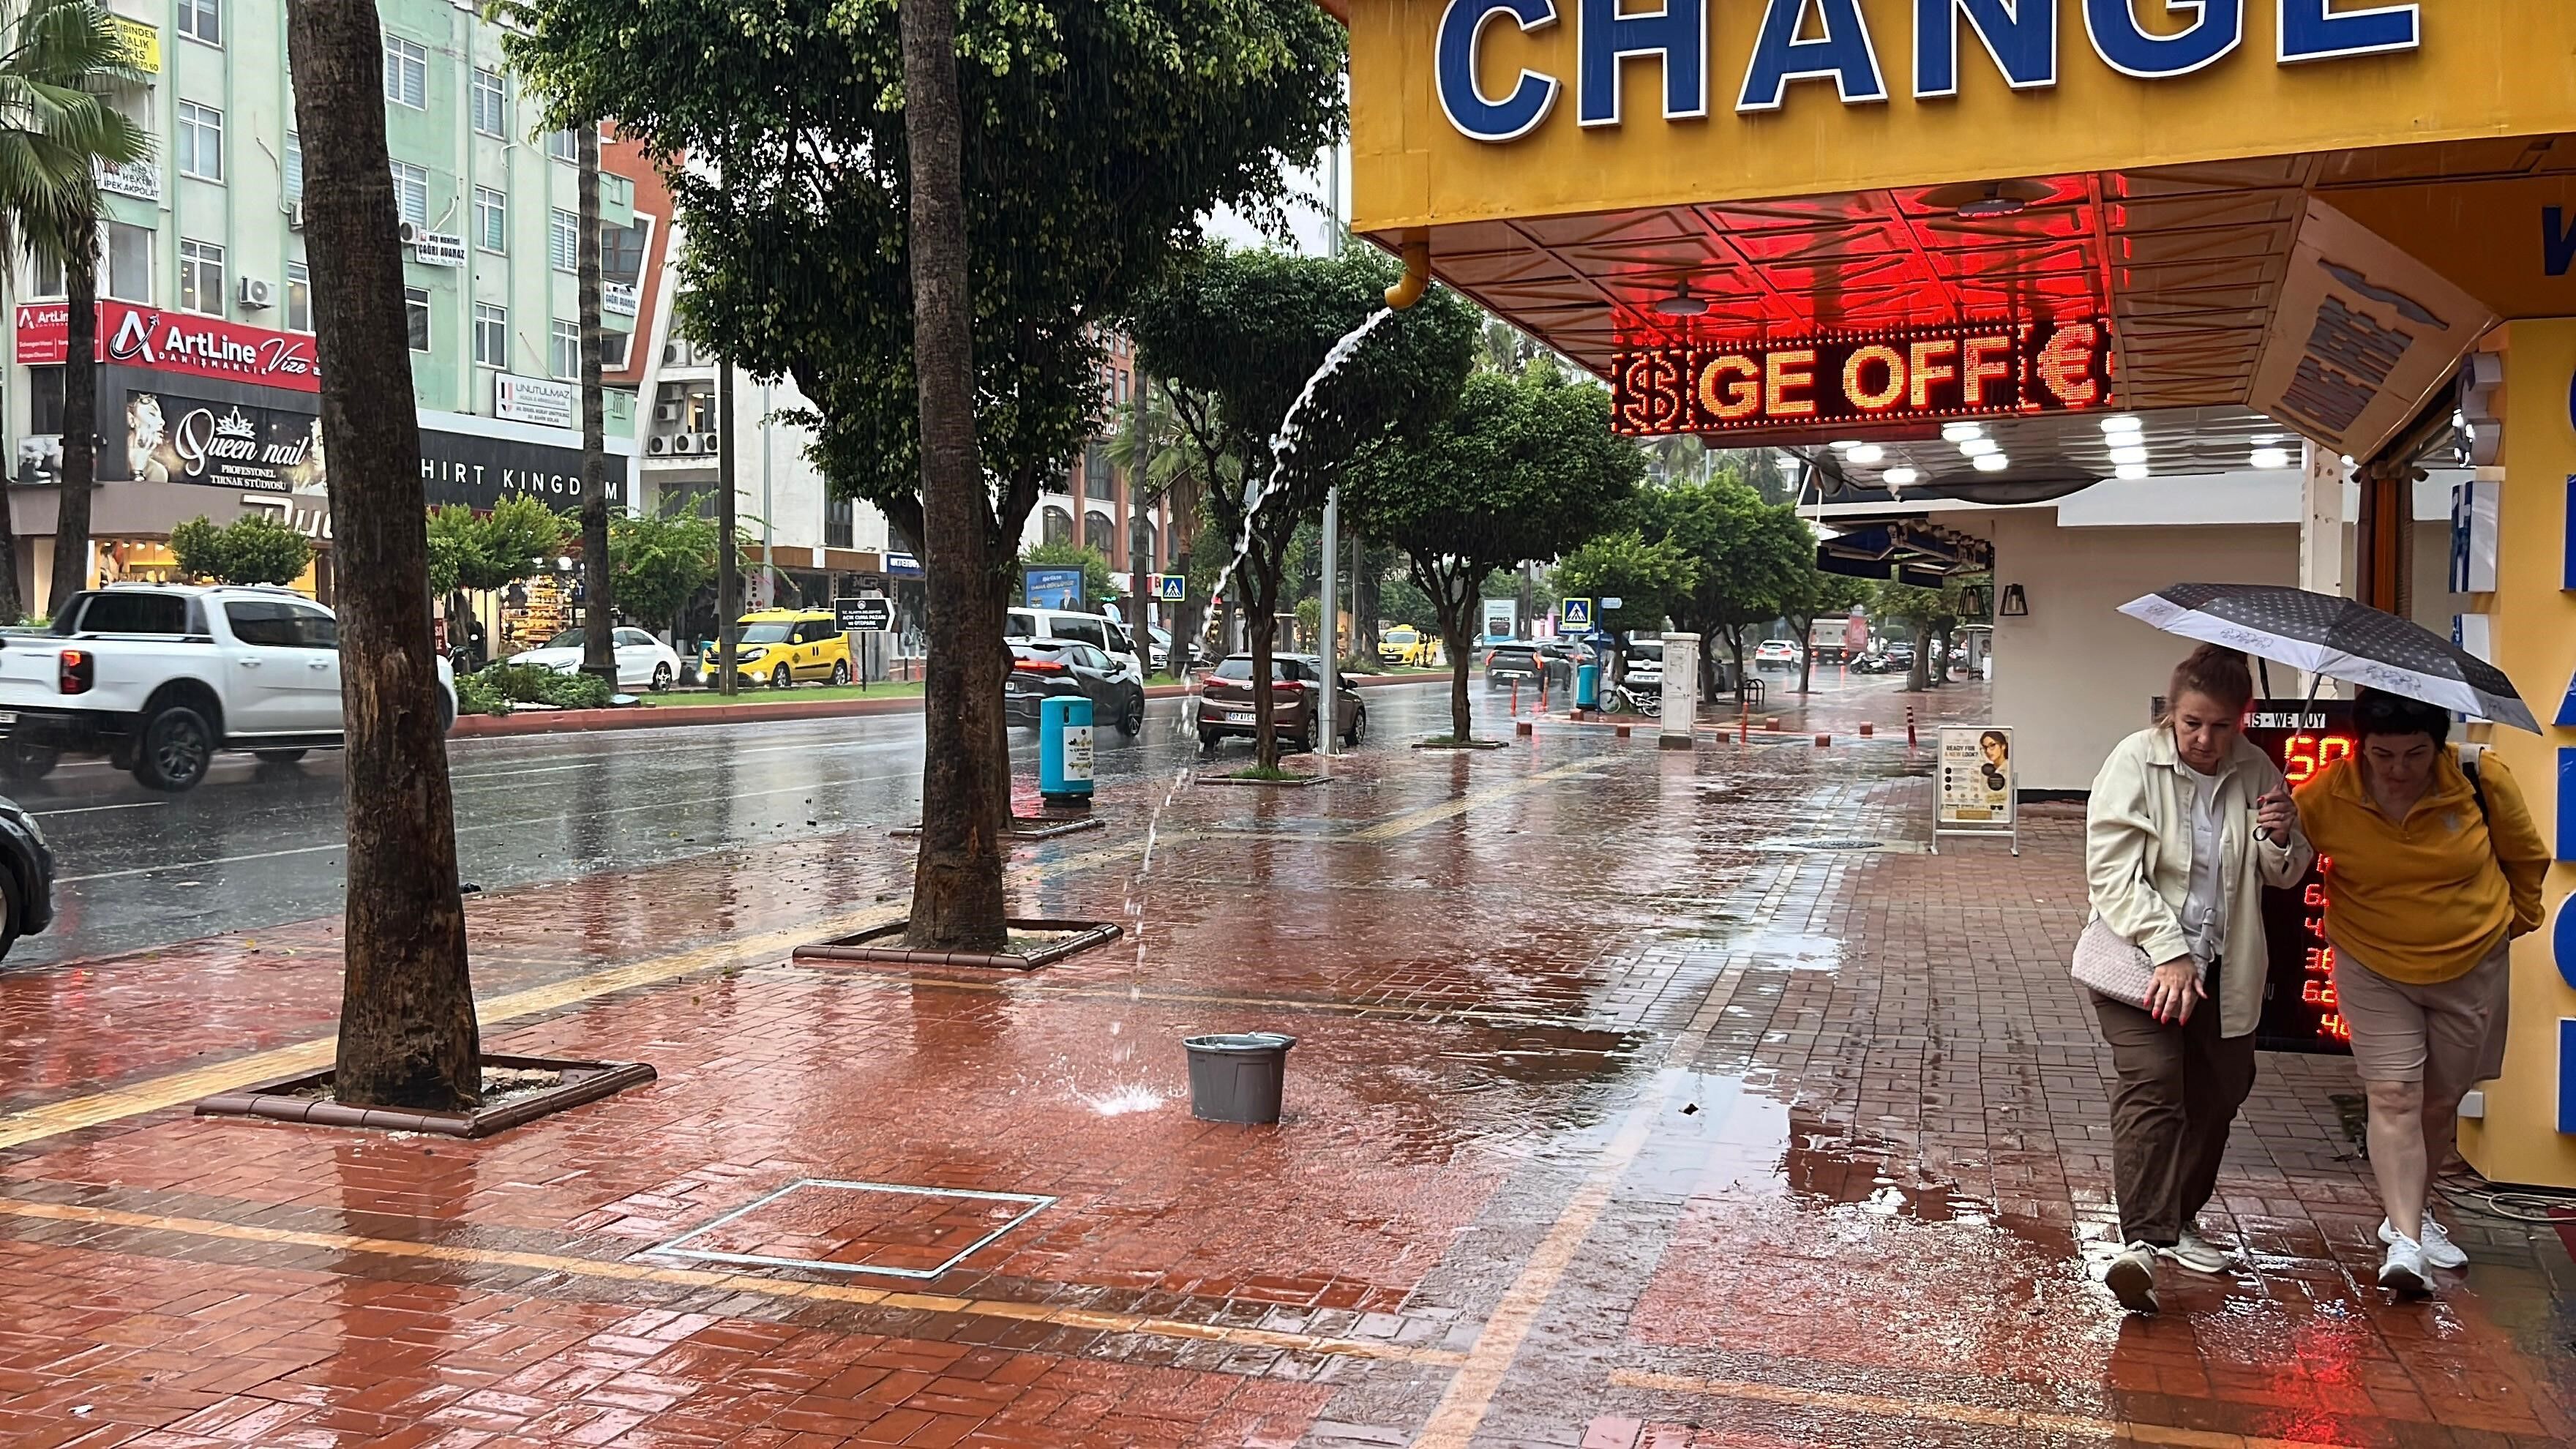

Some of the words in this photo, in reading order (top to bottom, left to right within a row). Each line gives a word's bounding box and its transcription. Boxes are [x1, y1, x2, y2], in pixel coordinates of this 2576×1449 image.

[38, 310, 68, 323] ArtLin
[165, 326, 256, 364] ArtLine
[260, 337, 311, 375] Vize
[515, 383, 570, 399] UNUTULMAZ
[175, 408, 258, 476] Queen
[262, 436, 309, 466] nail
[221, 464, 276, 479] PROFESYONEL
[420, 457, 484, 485] HIRT
[503, 468, 618, 501] KINGDM
[210, 474, 243, 488] TIRNAK
[2274, 714, 2292, 727] WE
